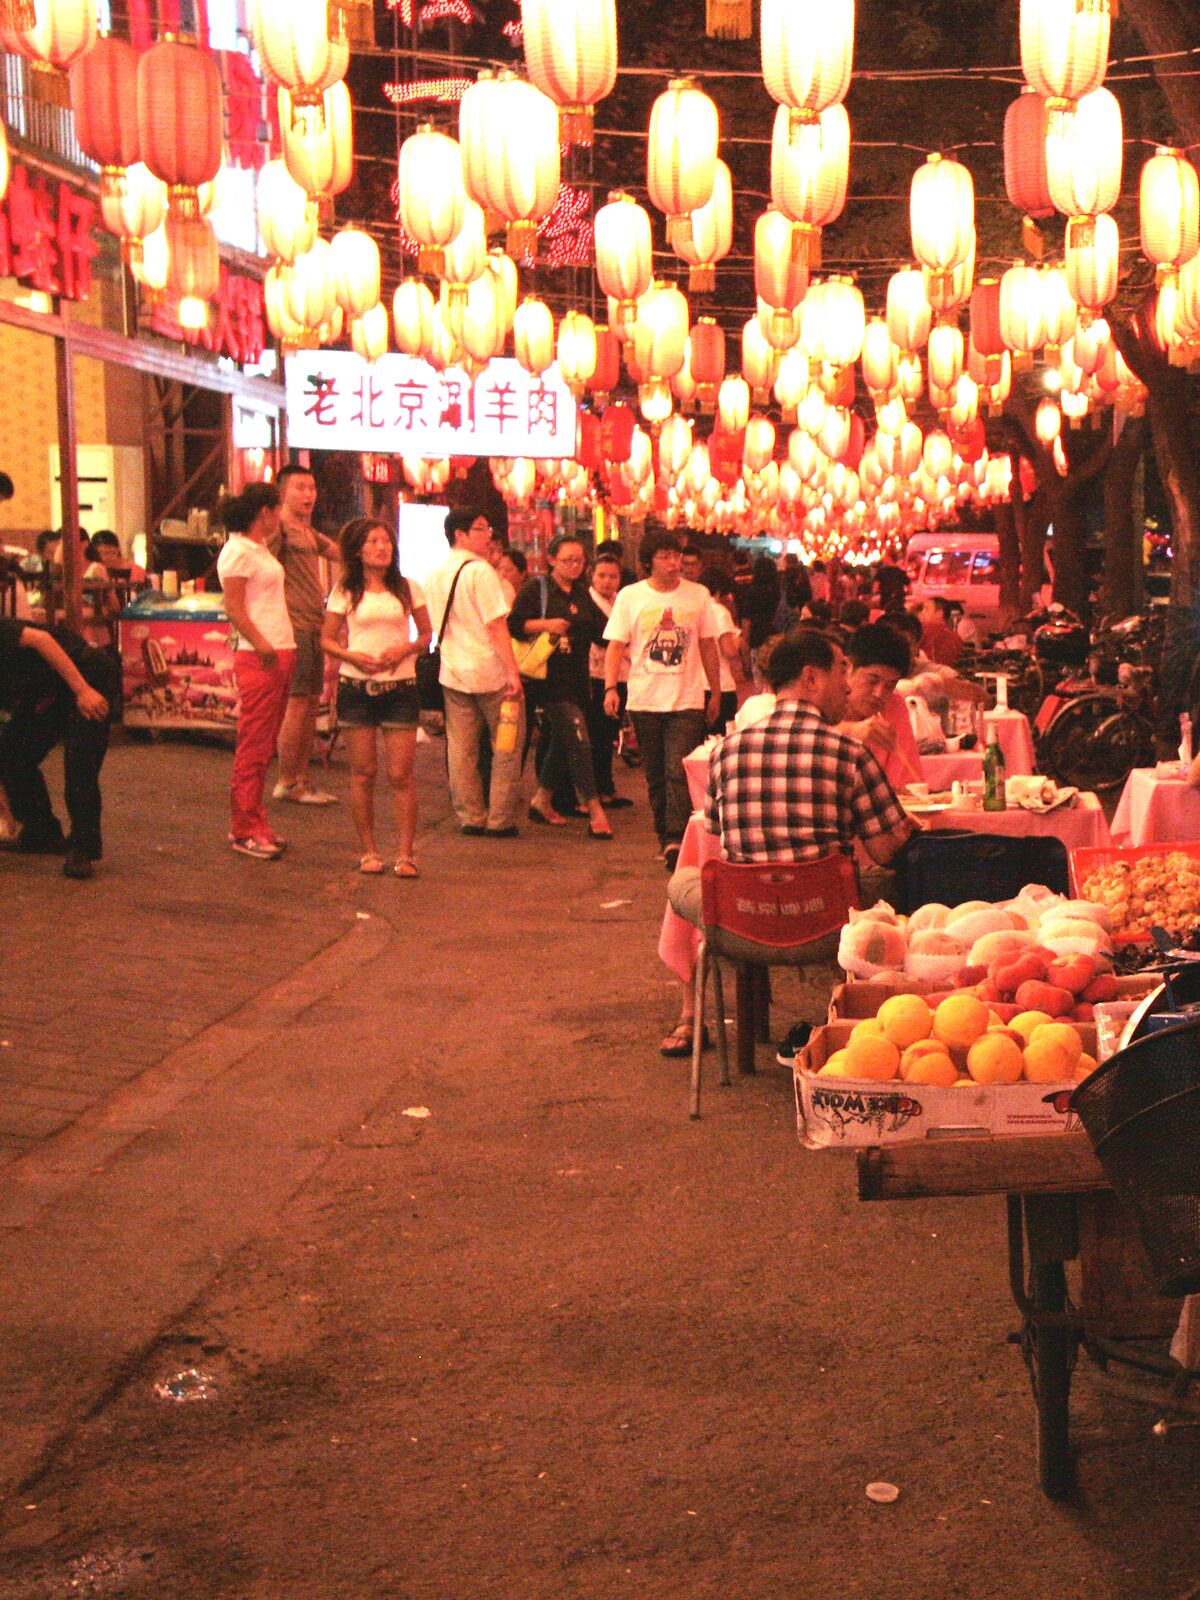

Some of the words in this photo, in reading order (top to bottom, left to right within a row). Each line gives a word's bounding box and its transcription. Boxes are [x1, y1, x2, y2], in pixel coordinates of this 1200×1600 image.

[303, 371, 557, 436] 老北京涮羊肉
